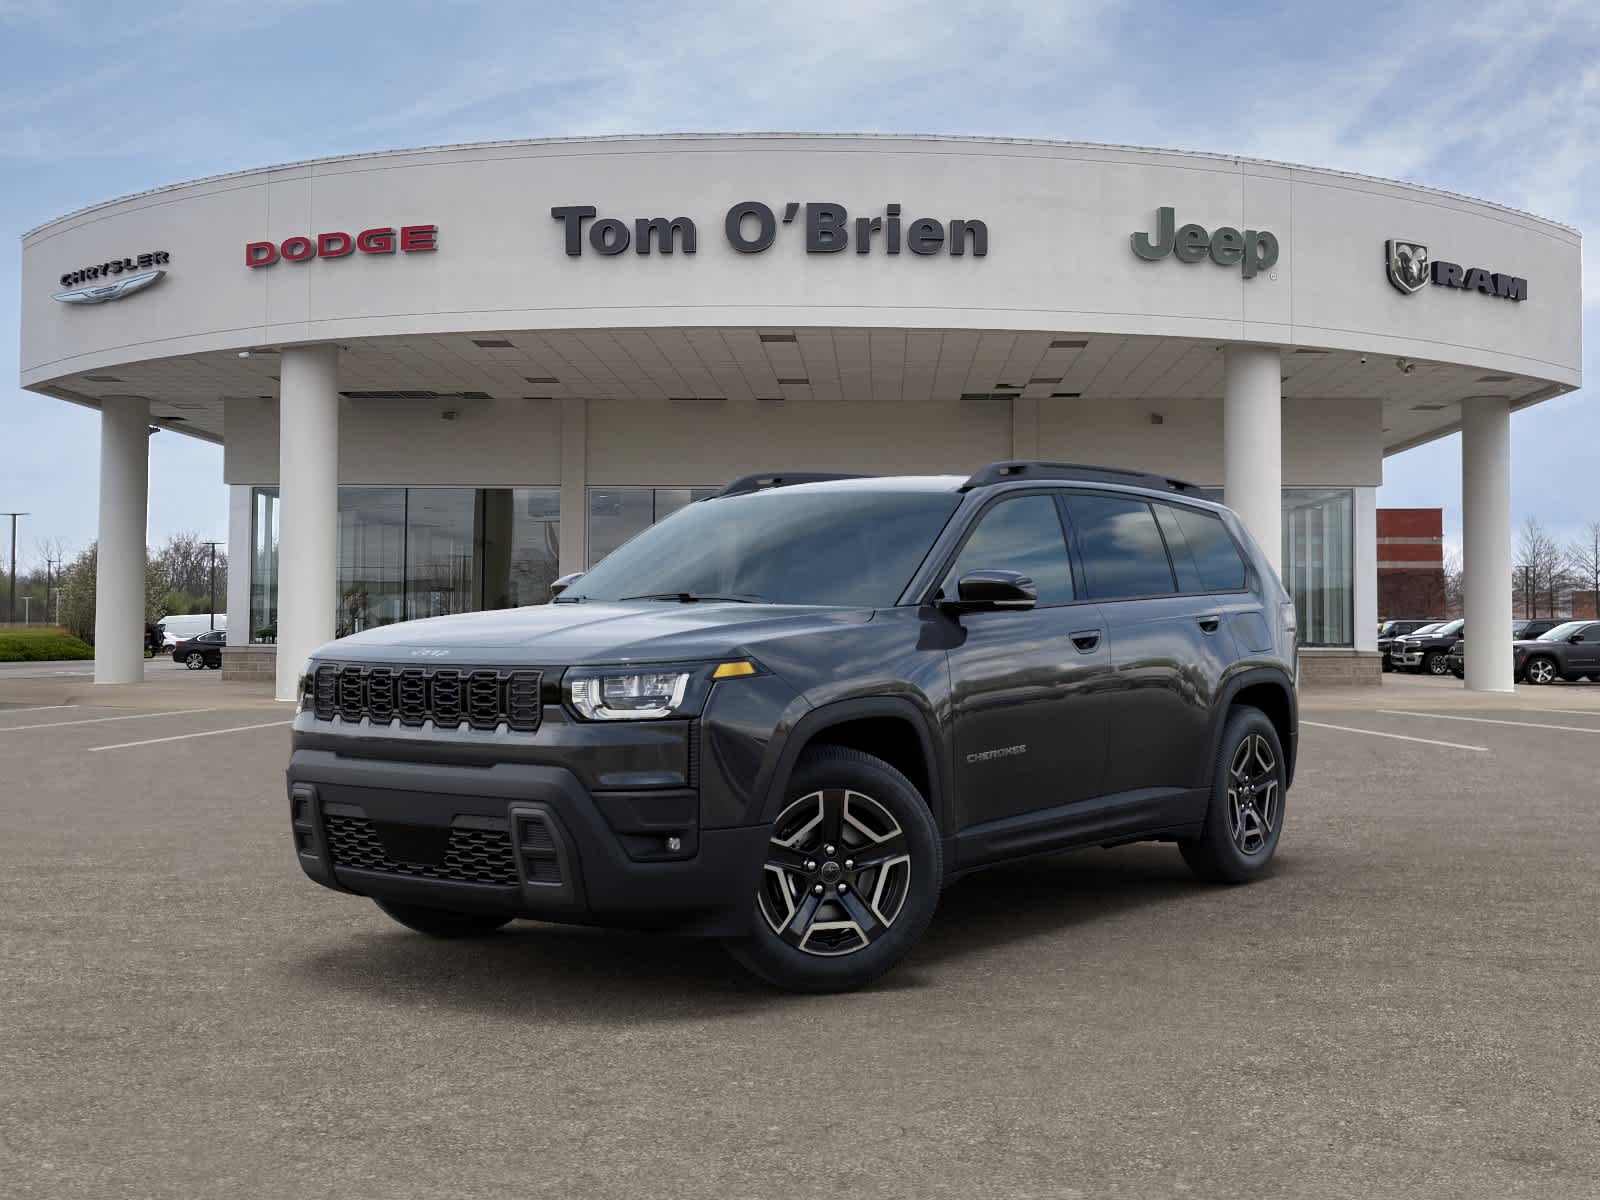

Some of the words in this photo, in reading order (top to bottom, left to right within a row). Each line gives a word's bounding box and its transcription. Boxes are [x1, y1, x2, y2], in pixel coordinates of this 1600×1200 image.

[246, 225, 438, 269] DODGE
[551, 205, 697, 256] Tom
[725, 201, 989, 256] O'Brien
[1131, 207, 1279, 279] Jeep
[60, 250, 170, 287] CHRYSLER
[1431, 261, 1528, 302] RAM
[966, 744, 1027, 763] CHEROKEE
